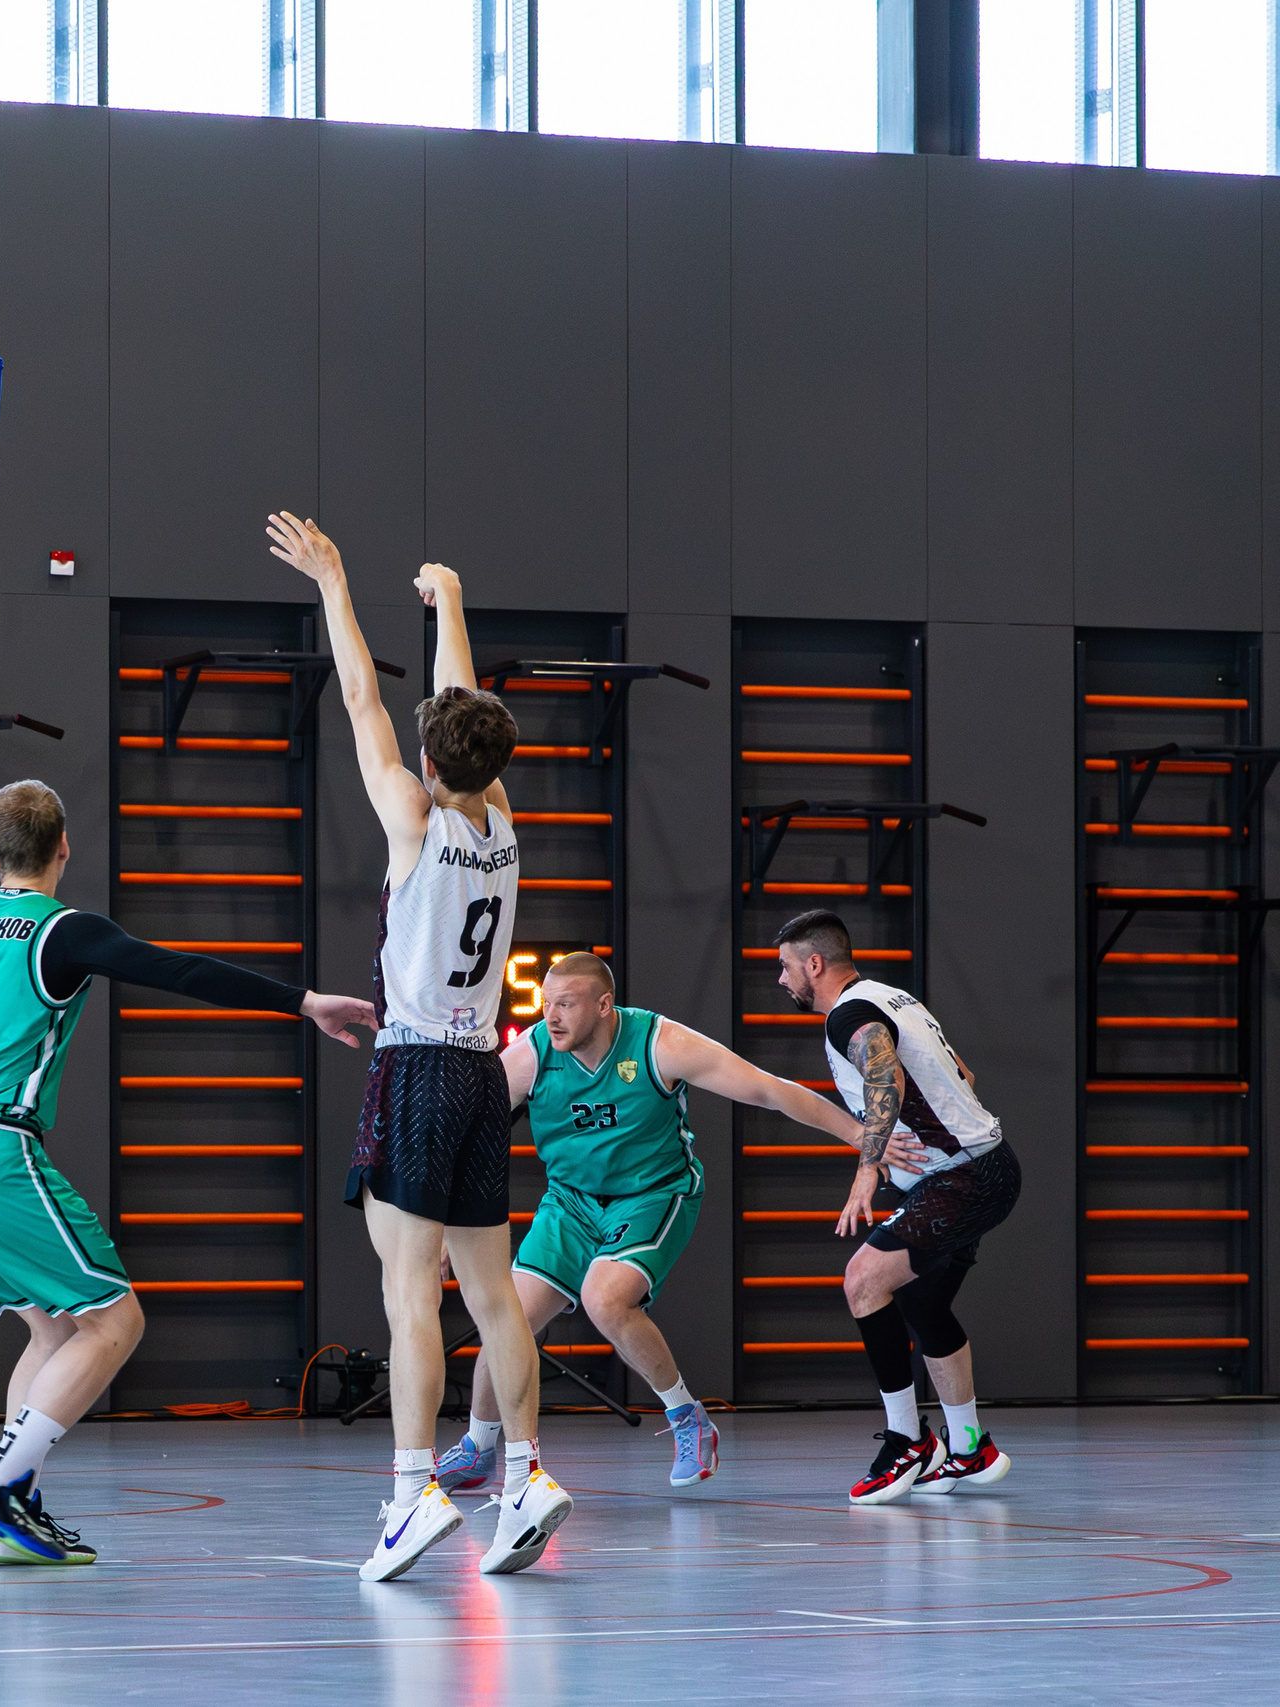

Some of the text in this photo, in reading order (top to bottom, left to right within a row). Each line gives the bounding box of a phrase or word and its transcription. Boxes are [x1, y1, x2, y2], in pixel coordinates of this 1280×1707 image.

[447, 895, 502, 988] 9
[444, 1029, 488, 1049] Новая
[571, 1103, 618, 1129] 23
